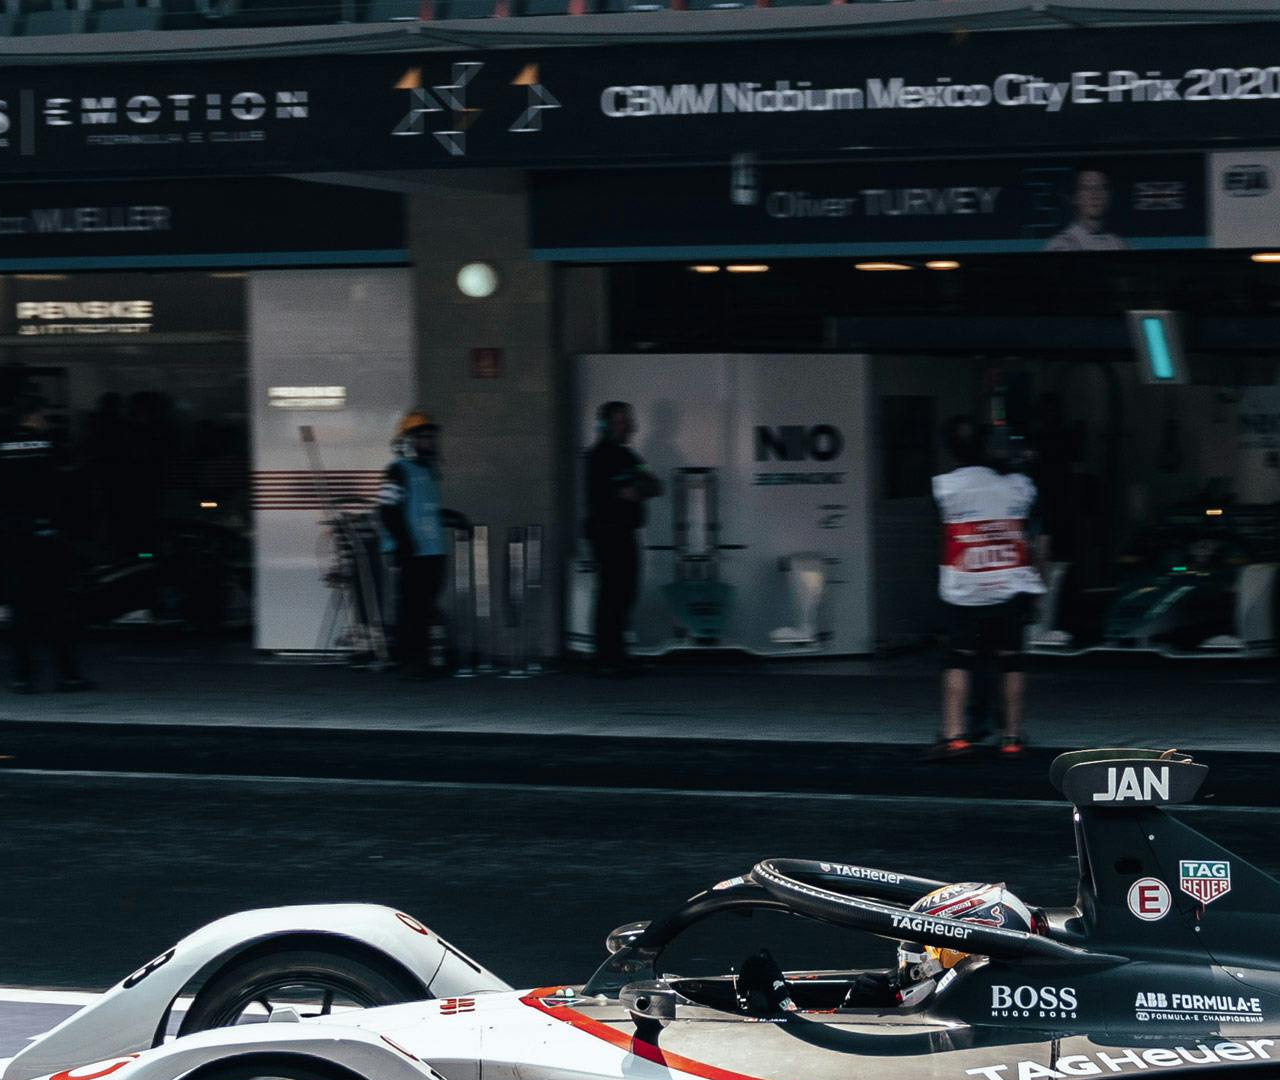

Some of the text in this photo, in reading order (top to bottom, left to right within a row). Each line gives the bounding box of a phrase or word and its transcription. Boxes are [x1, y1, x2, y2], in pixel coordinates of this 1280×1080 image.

[866, 77, 993, 110] Mexico
[994, 73, 1070, 112] City
[1071, 70, 1183, 105] E-Prix
[45, 90, 310, 127] EMOTION
[1093, 766, 1169, 801] JAN
[1183, 862, 1227, 878] TAG
[1138, 885, 1162, 914] E
[1182, 879, 1229, 901] HEUER
[991, 985, 1078, 1010] BOSS
[1135, 991, 1168, 1008] ABB
[991, 1010, 1078, 1019] HUGO BOSS
